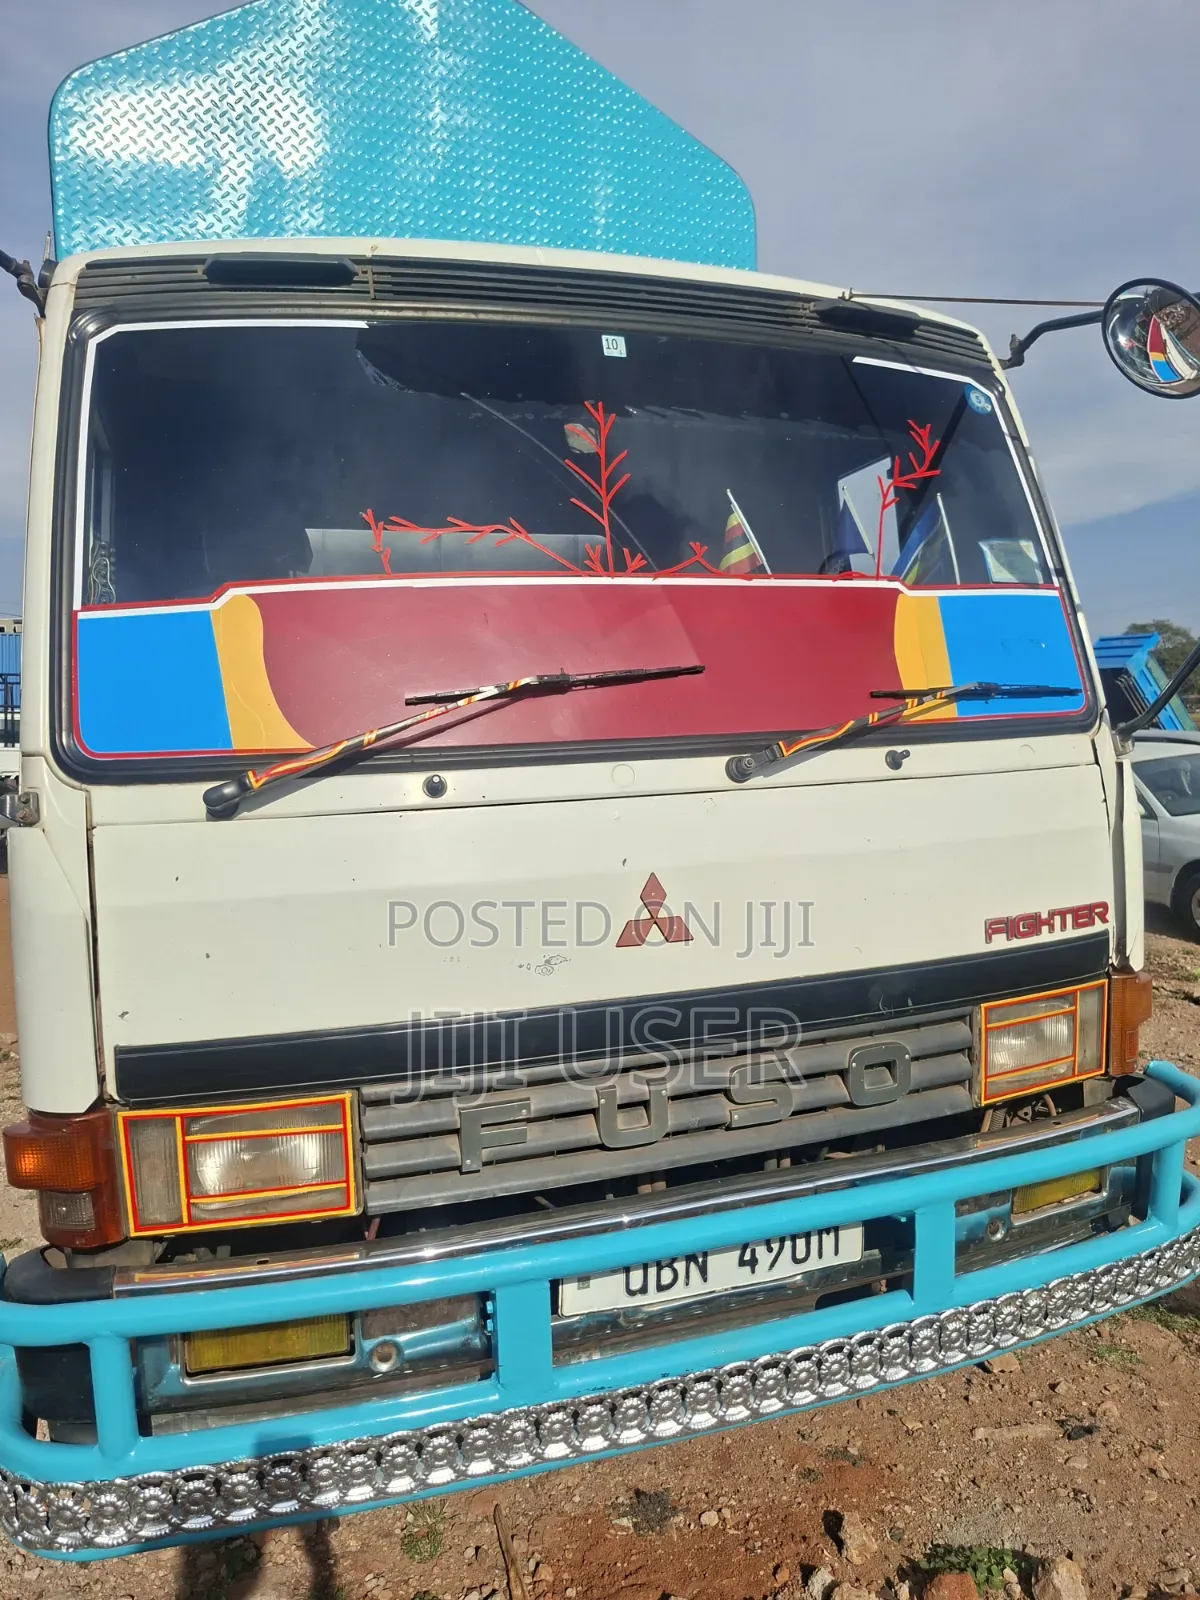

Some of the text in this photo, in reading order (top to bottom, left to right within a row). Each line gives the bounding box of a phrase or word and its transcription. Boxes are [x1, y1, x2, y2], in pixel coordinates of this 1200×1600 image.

[605, 338, 618, 350] 10
[985, 901, 1109, 944] FIGHTER
[459, 1040, 912, 1173] FUSO
